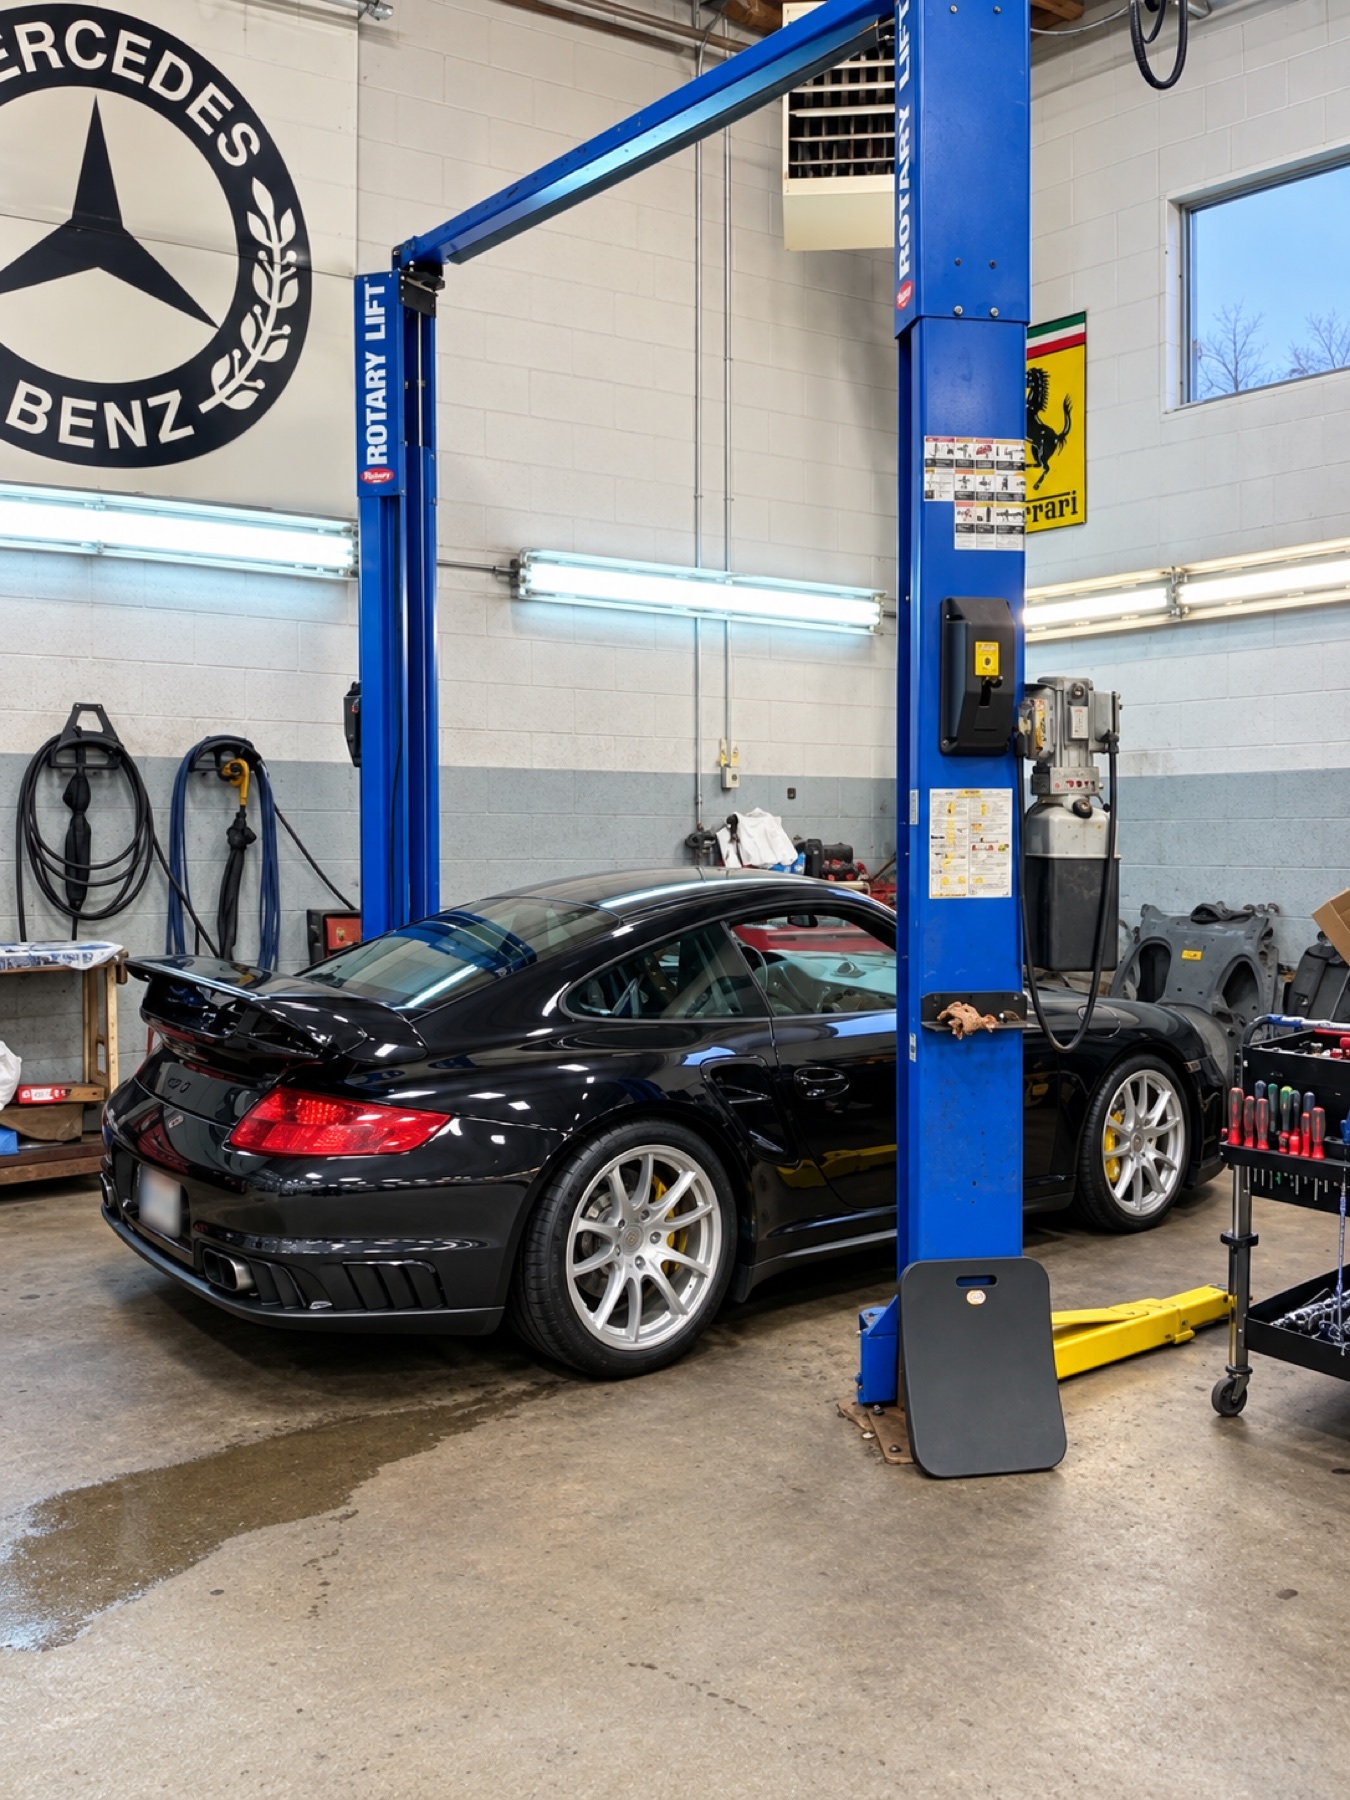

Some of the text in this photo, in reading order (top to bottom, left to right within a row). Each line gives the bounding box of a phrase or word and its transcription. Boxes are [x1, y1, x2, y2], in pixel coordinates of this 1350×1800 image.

[898, 0, 910, 91] LIFT
[899, 104, 911, 280] ROTARY
[5, 379, 195, 449] BENZ
[364, 282, 388, 465] ROTARY LIFT
